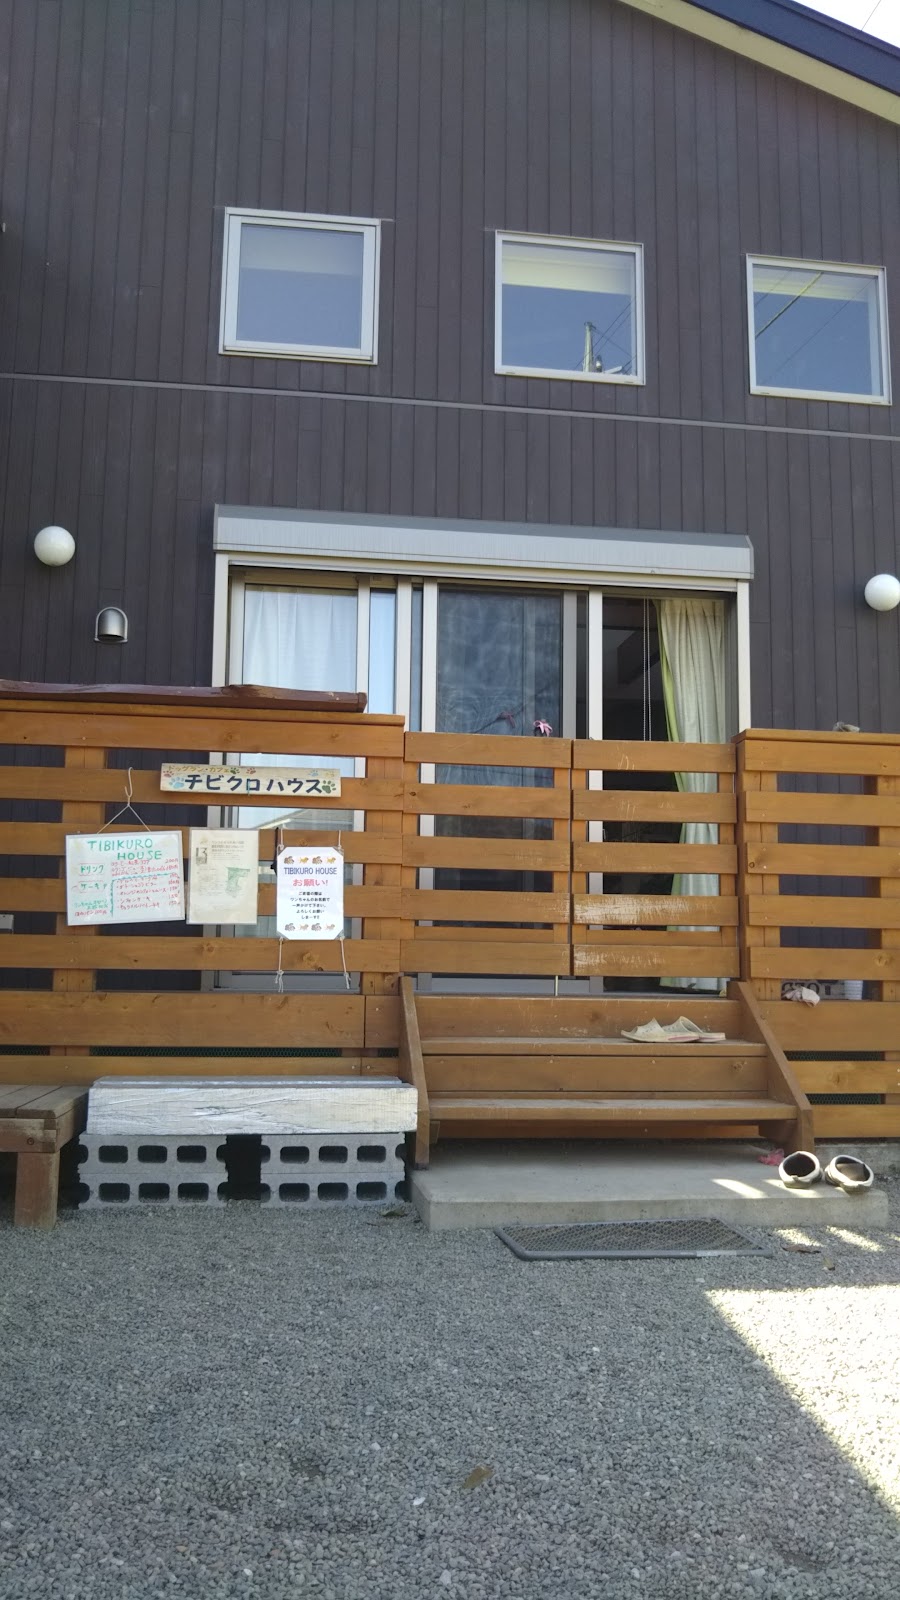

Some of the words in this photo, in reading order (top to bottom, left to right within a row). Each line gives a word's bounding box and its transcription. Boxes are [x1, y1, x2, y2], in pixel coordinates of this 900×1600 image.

[184, 773, 323, 794] チビクロハウス
[87, 838, 153, 851] TIBIKURO
[117, 850, 162, 861] HOUSE
[80, 864, 104, 873] ドリンク
[283, 867, 313, 875] TIBIKURO
[315, 867, 337, 875] HOUSE
[292, 879, 329, 887] お願い!
